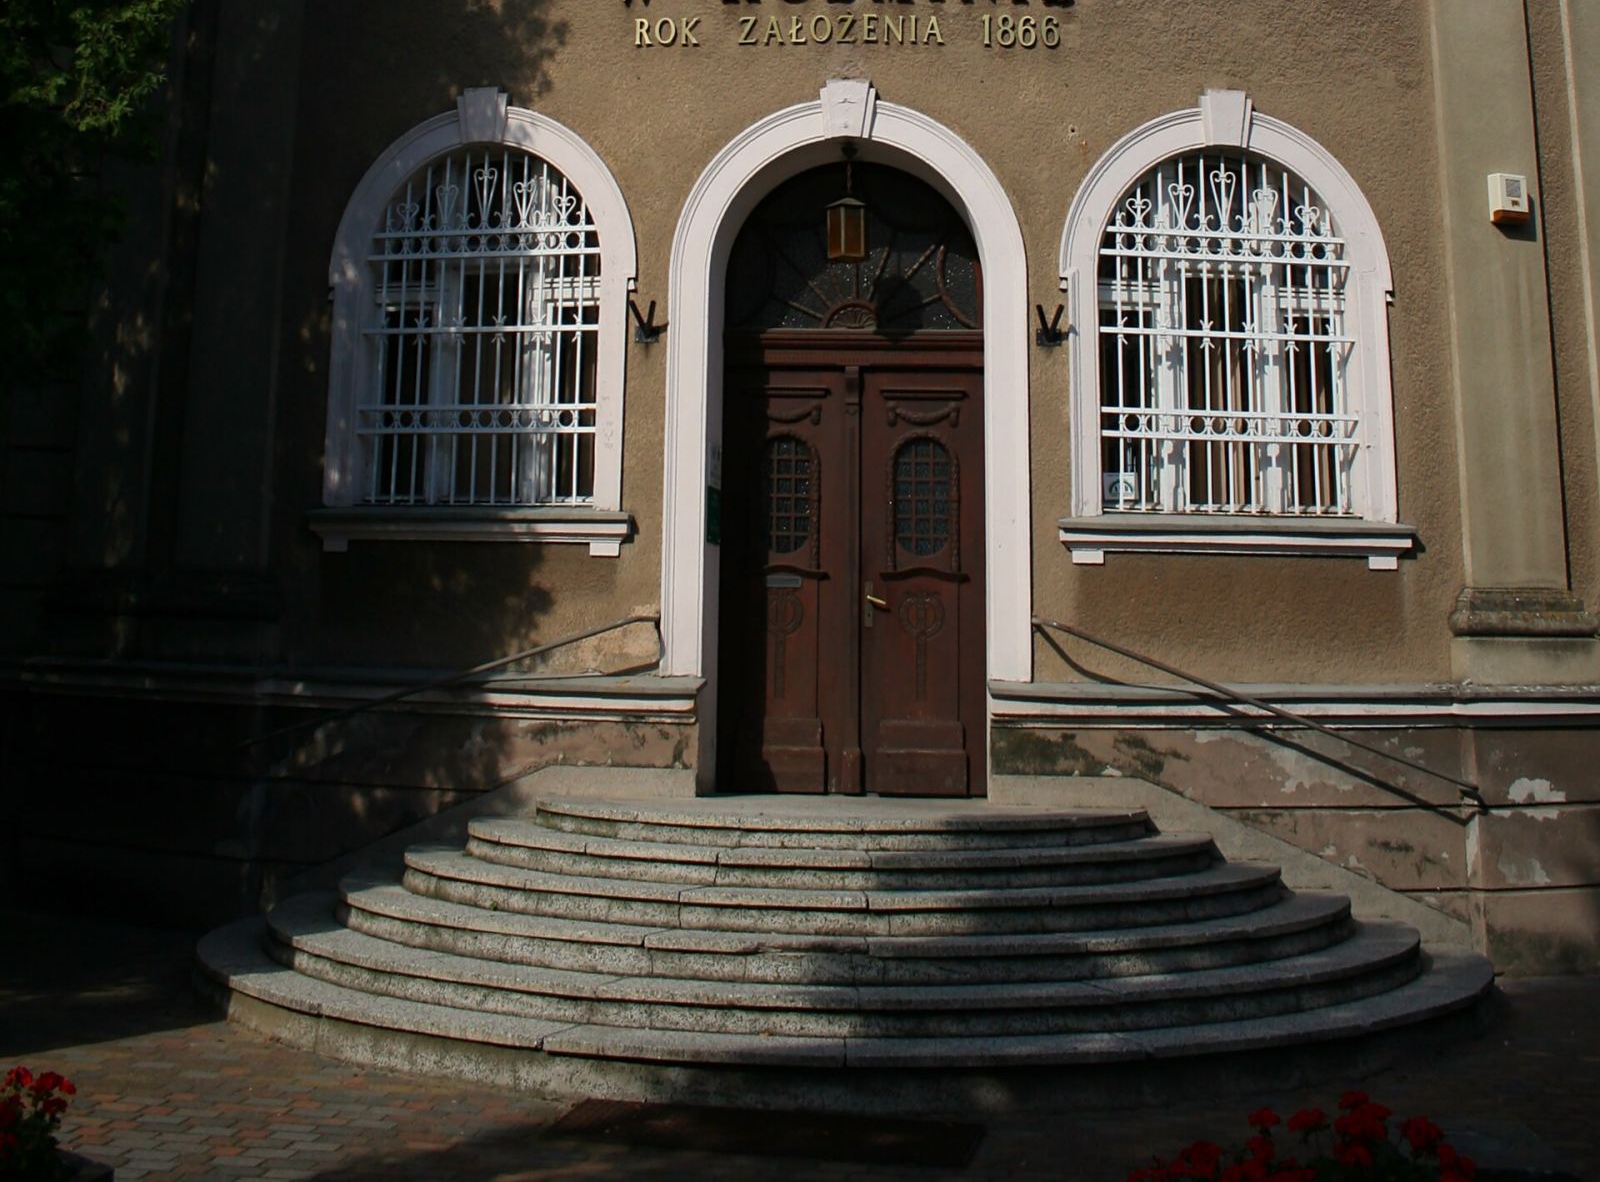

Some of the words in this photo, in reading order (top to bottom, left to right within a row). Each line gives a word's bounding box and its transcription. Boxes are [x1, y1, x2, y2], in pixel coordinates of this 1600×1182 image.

[634, 17, 699, 46] ROK
[738, 11, 945, 45] ZAŁOŻENIA
[982, 14, 1061, 47] 1866
